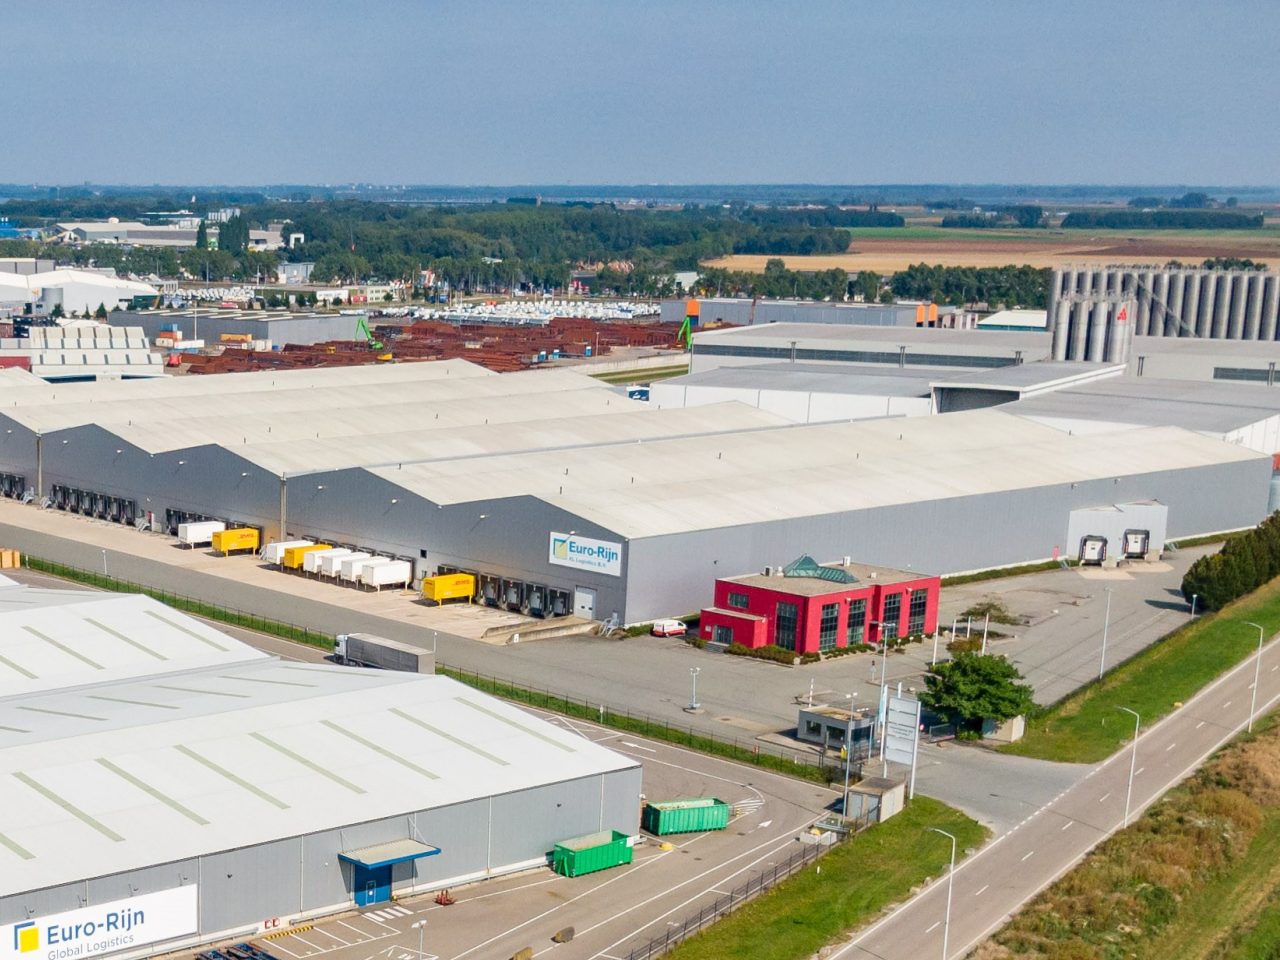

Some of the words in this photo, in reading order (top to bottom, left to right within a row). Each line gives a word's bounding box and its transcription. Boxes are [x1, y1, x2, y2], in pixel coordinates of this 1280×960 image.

[569, 541, 618, 563] Euro-Rijn
[47, 908, 145, 945] Euro-Rijn
[48, 943, 83, 960] Global
[87, 934, 134, 953] Logistics
